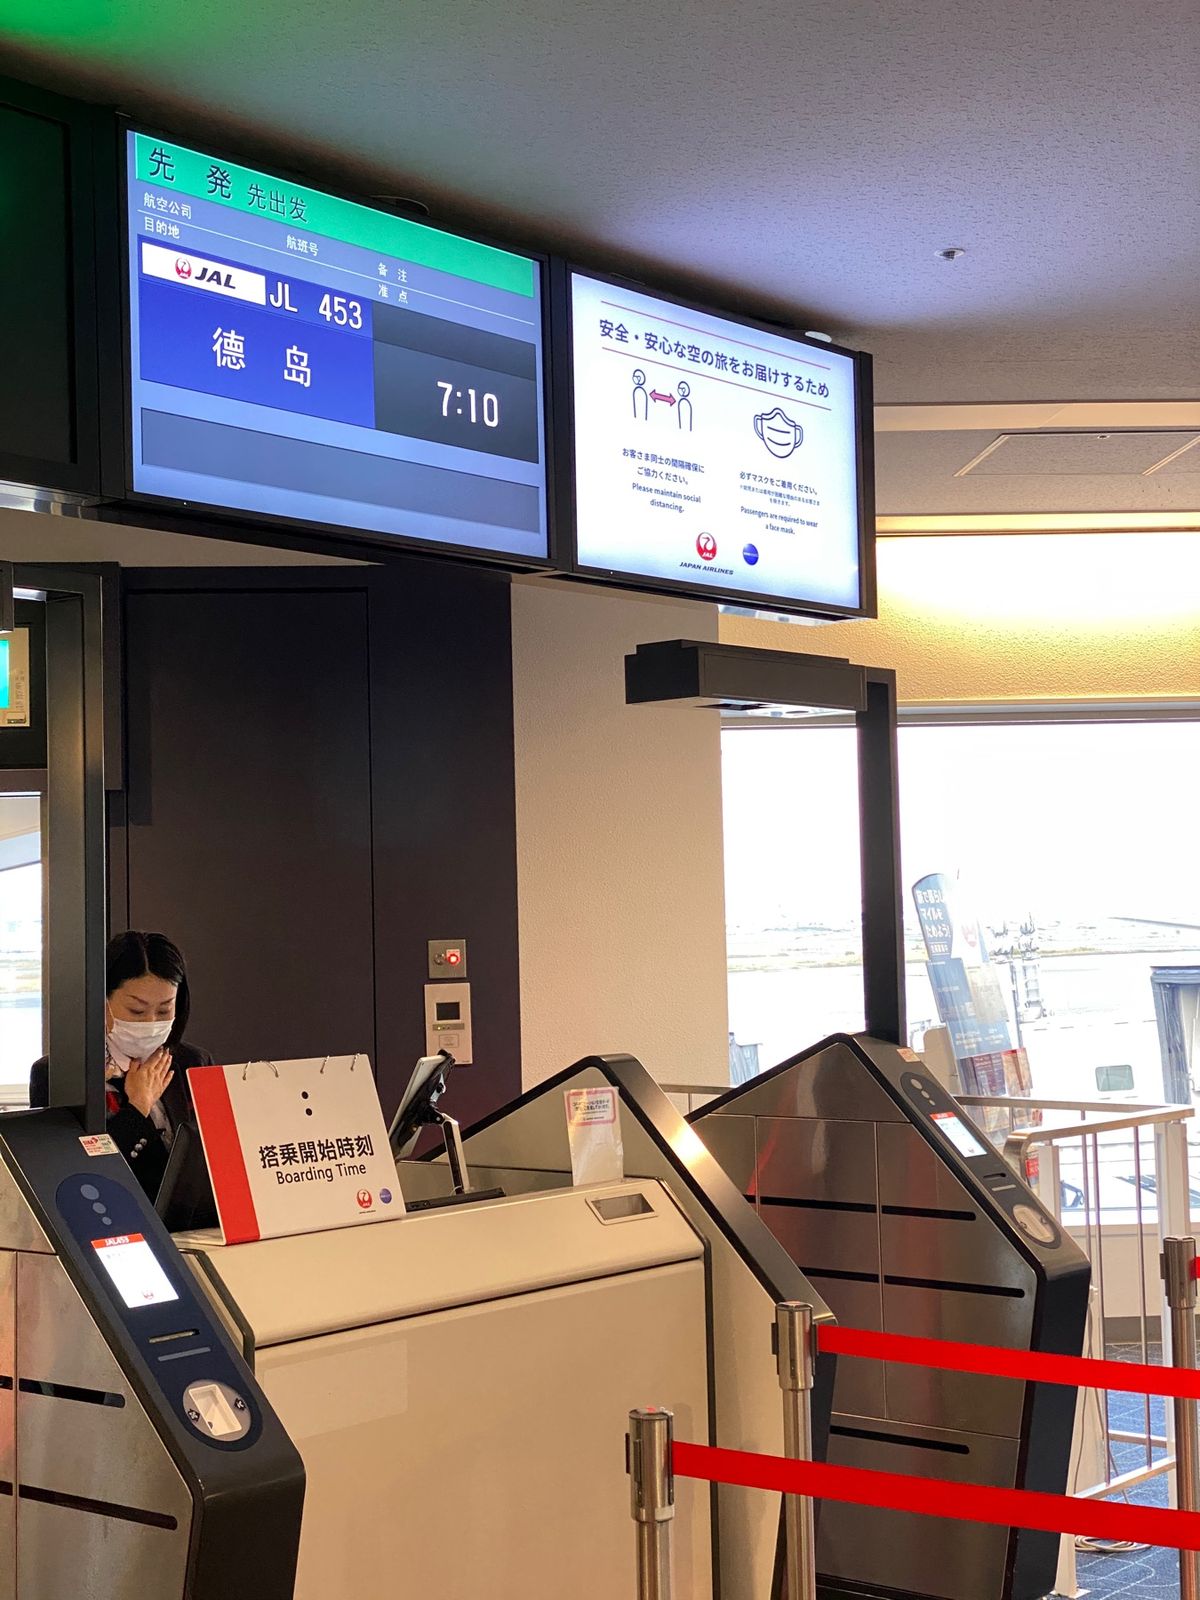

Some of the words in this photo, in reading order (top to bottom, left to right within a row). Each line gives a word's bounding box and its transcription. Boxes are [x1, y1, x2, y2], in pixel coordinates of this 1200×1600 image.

[143, 192, 192, 219] 航空公司
[247, 183, 308, 223] 先出发
[144, 216, 180, 239] 目的地
[286, 234, 319, 256] 航班号
[195, 267, 236, 290] JAL
[269, 281, 298, 312] JL
[318, 294, 362, 330] 453
[600, 319, 830, 399] 安全・安心な空の旅をお届けするため
[437, 381, 499, 428] 7:10
[632, 482, 653, 494] Please
[654, 488, 682, 499] maintain
[683, 494, 701, 503] social
[650, 499, 684, 513] distancing.
[740, 506, 769, 518] Passengers
[778, 515, 800, 524] required
[805, 520, 818, 528] wear
[769, 523, 780, 531] face
[679, 561, 702, 570] JAPAN
[702, 565, 734, 575] AIRLINES
[259, 1134, 375, 1169] 搭乗開始時刻
[275, 1166, 334, 1185] Boarding
[335, 1162, 367, 1177] Time
